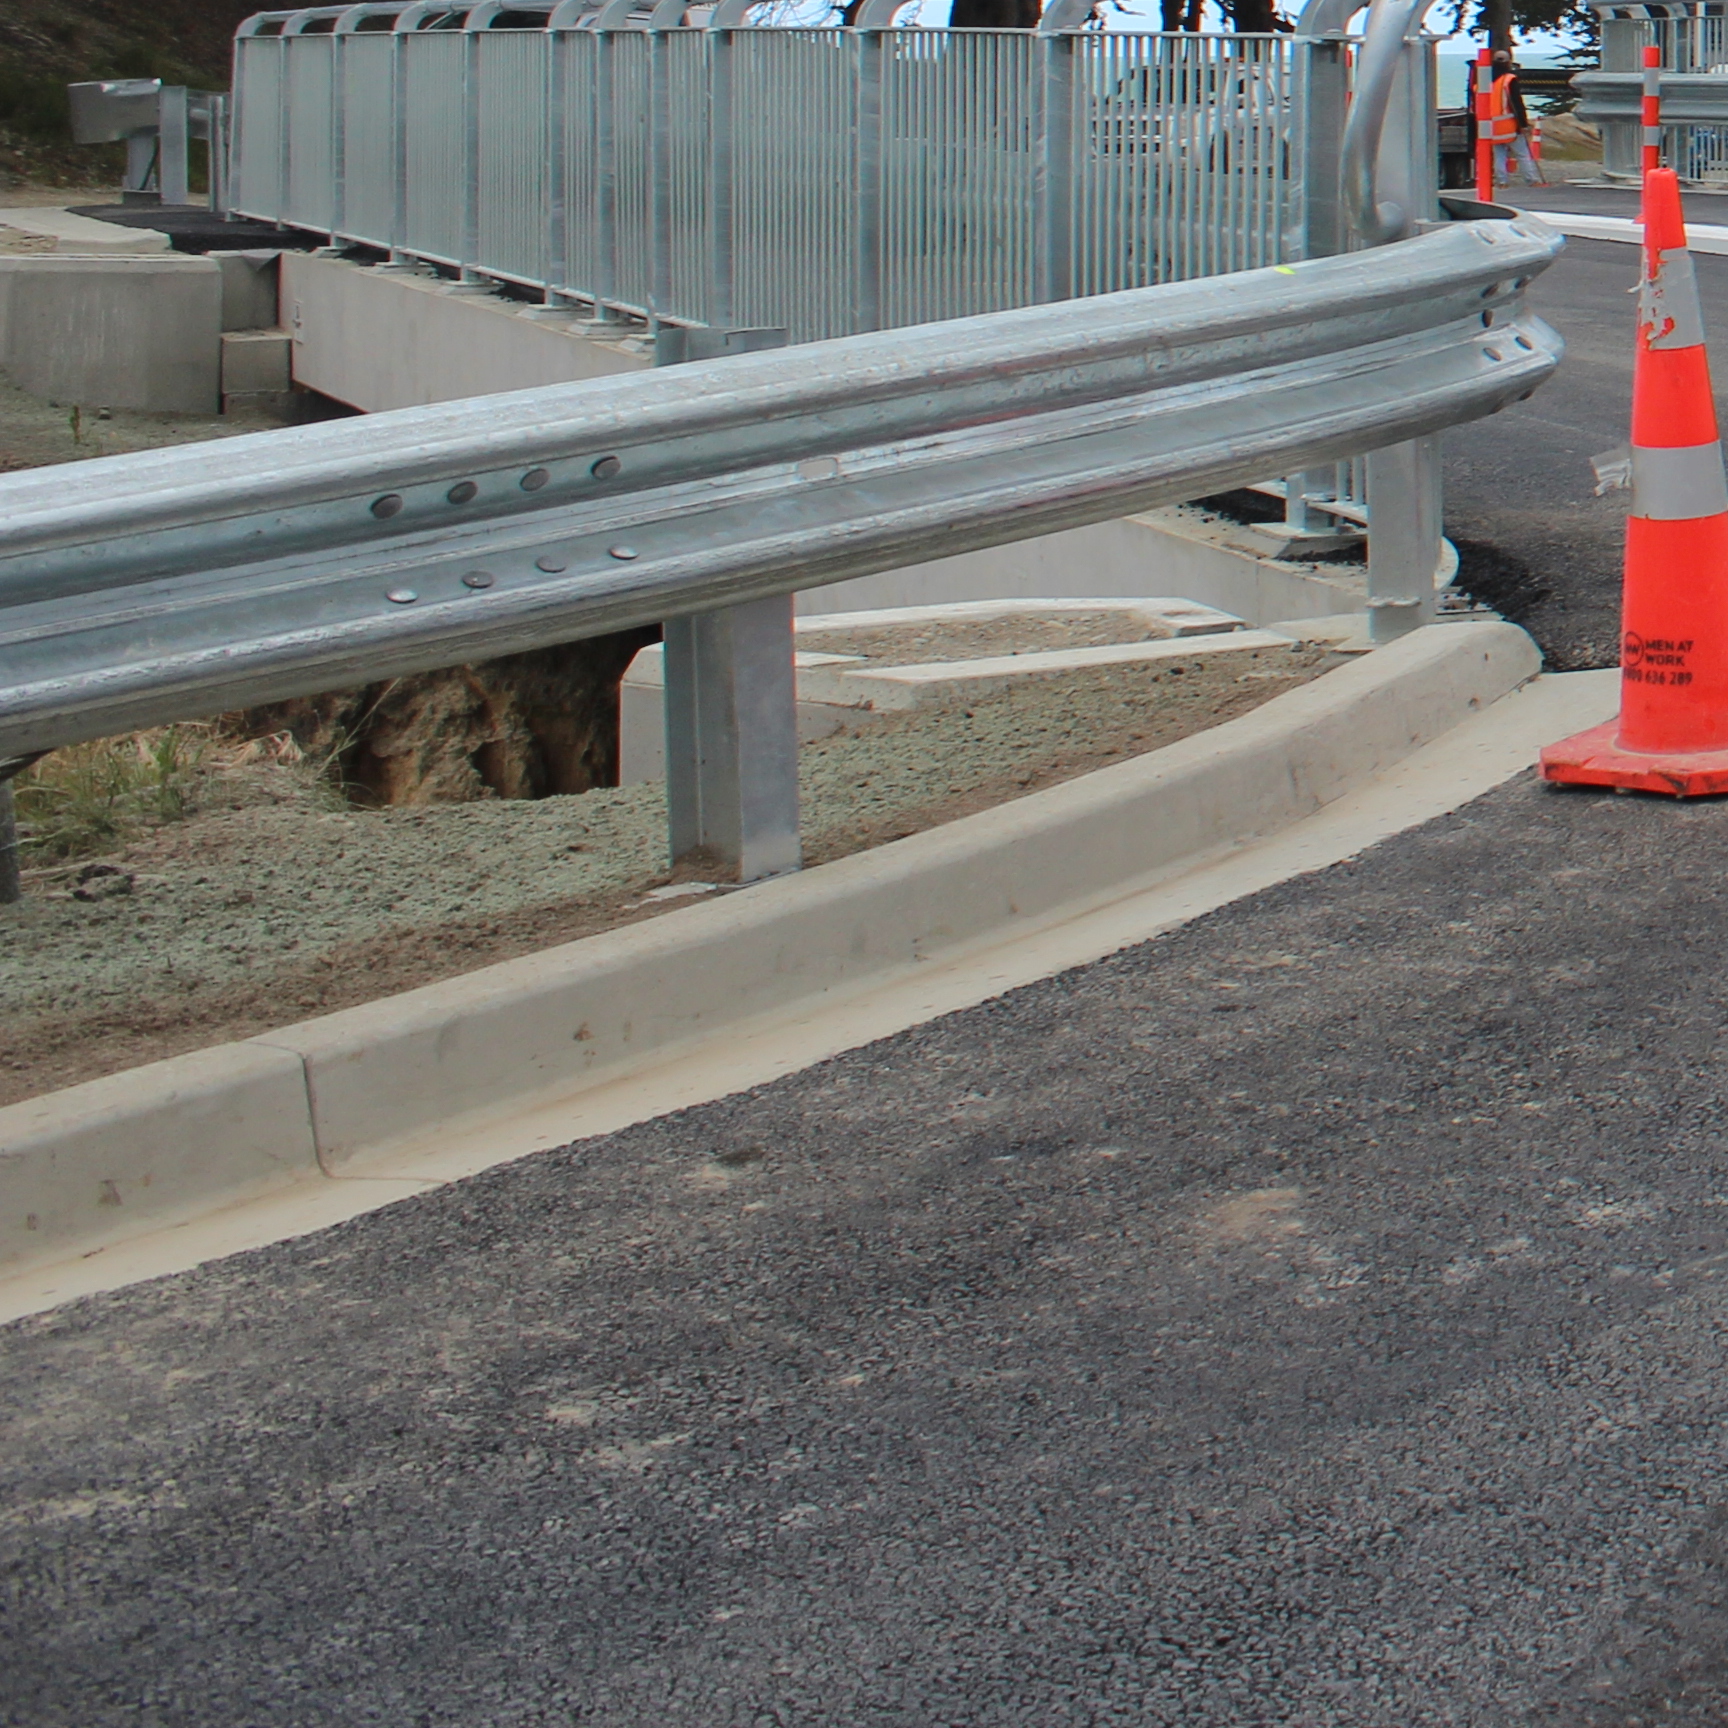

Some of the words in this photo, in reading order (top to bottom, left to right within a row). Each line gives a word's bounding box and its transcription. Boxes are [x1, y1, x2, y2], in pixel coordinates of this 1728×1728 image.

[1645, 639, 1674, 651] MEN
[1677, 640, 1694, 653] AT
[1645, 653, 1685, 667] WORK
[1645, 670, 1666, 685] 636
[1669, 672, 1693, 685] 289
